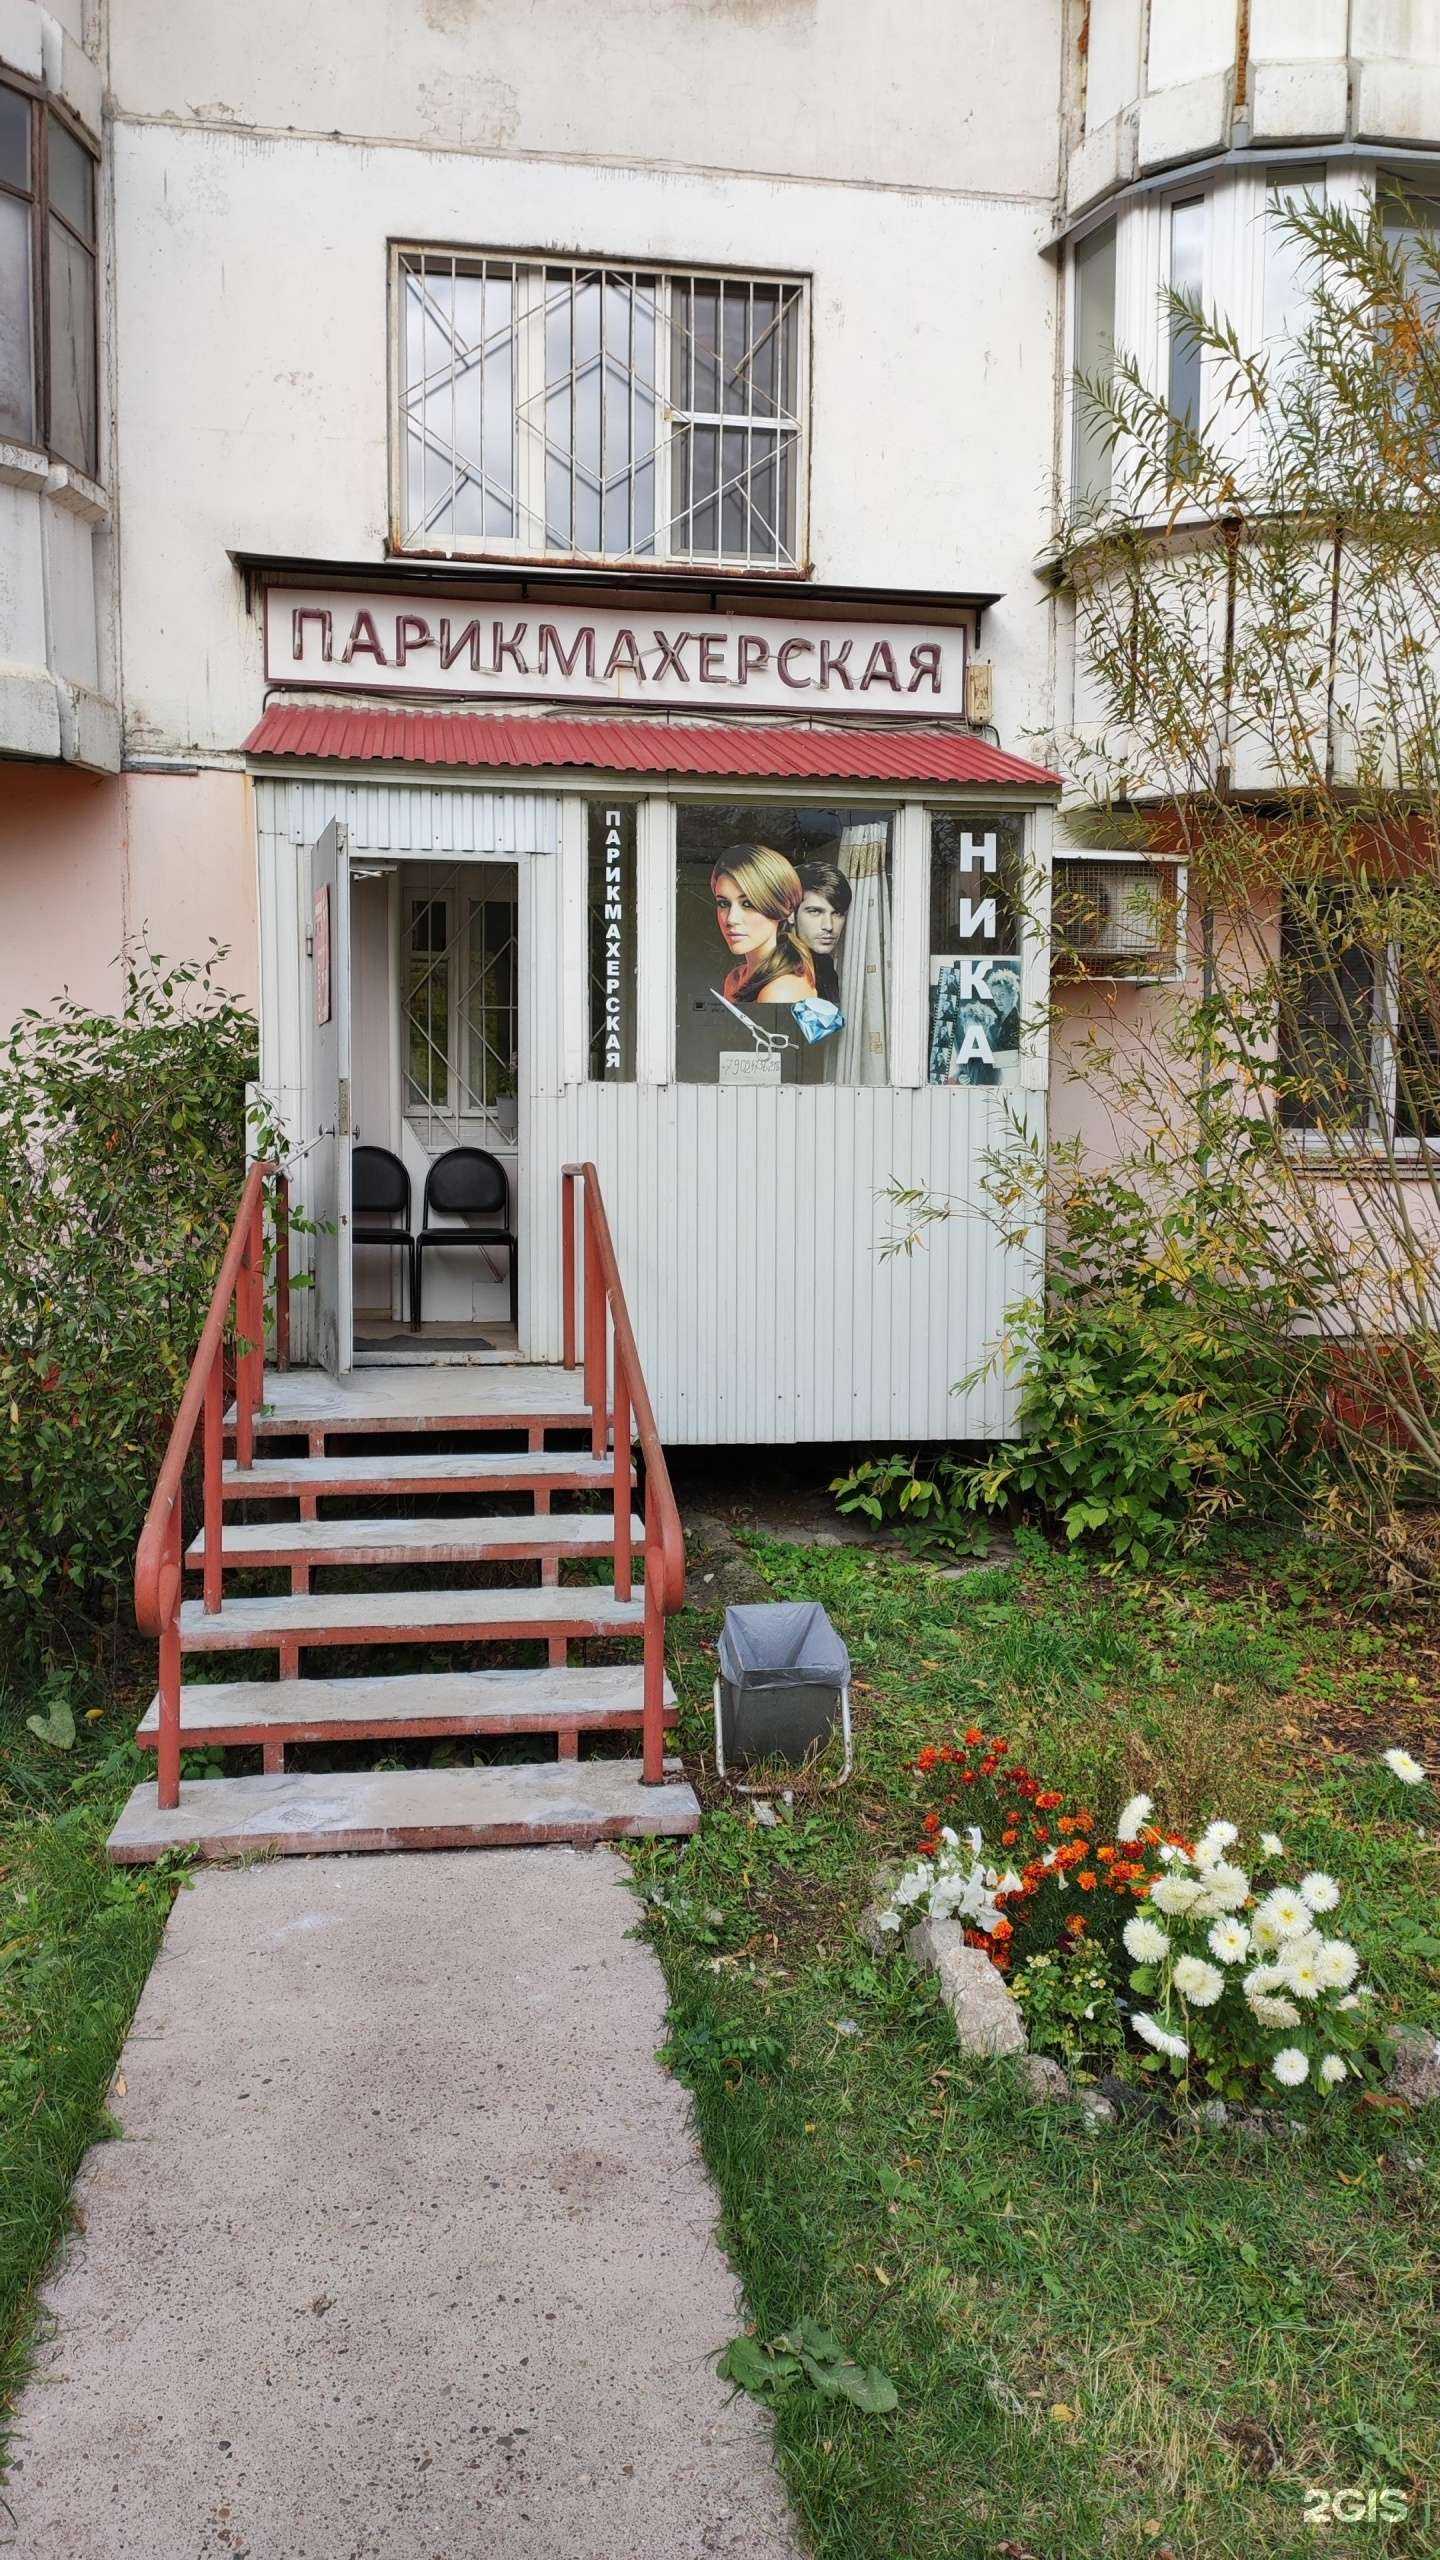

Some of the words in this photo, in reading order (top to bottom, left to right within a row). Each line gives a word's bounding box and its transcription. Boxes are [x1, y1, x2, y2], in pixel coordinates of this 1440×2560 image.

[290, 607, 943, 694] ПАРИКМАХЕРСКАЯ
[604, 810, 622, 1068] ПАРИКМАХЕРСКАЯ
[956, 832, 997, 1065] НИКА
